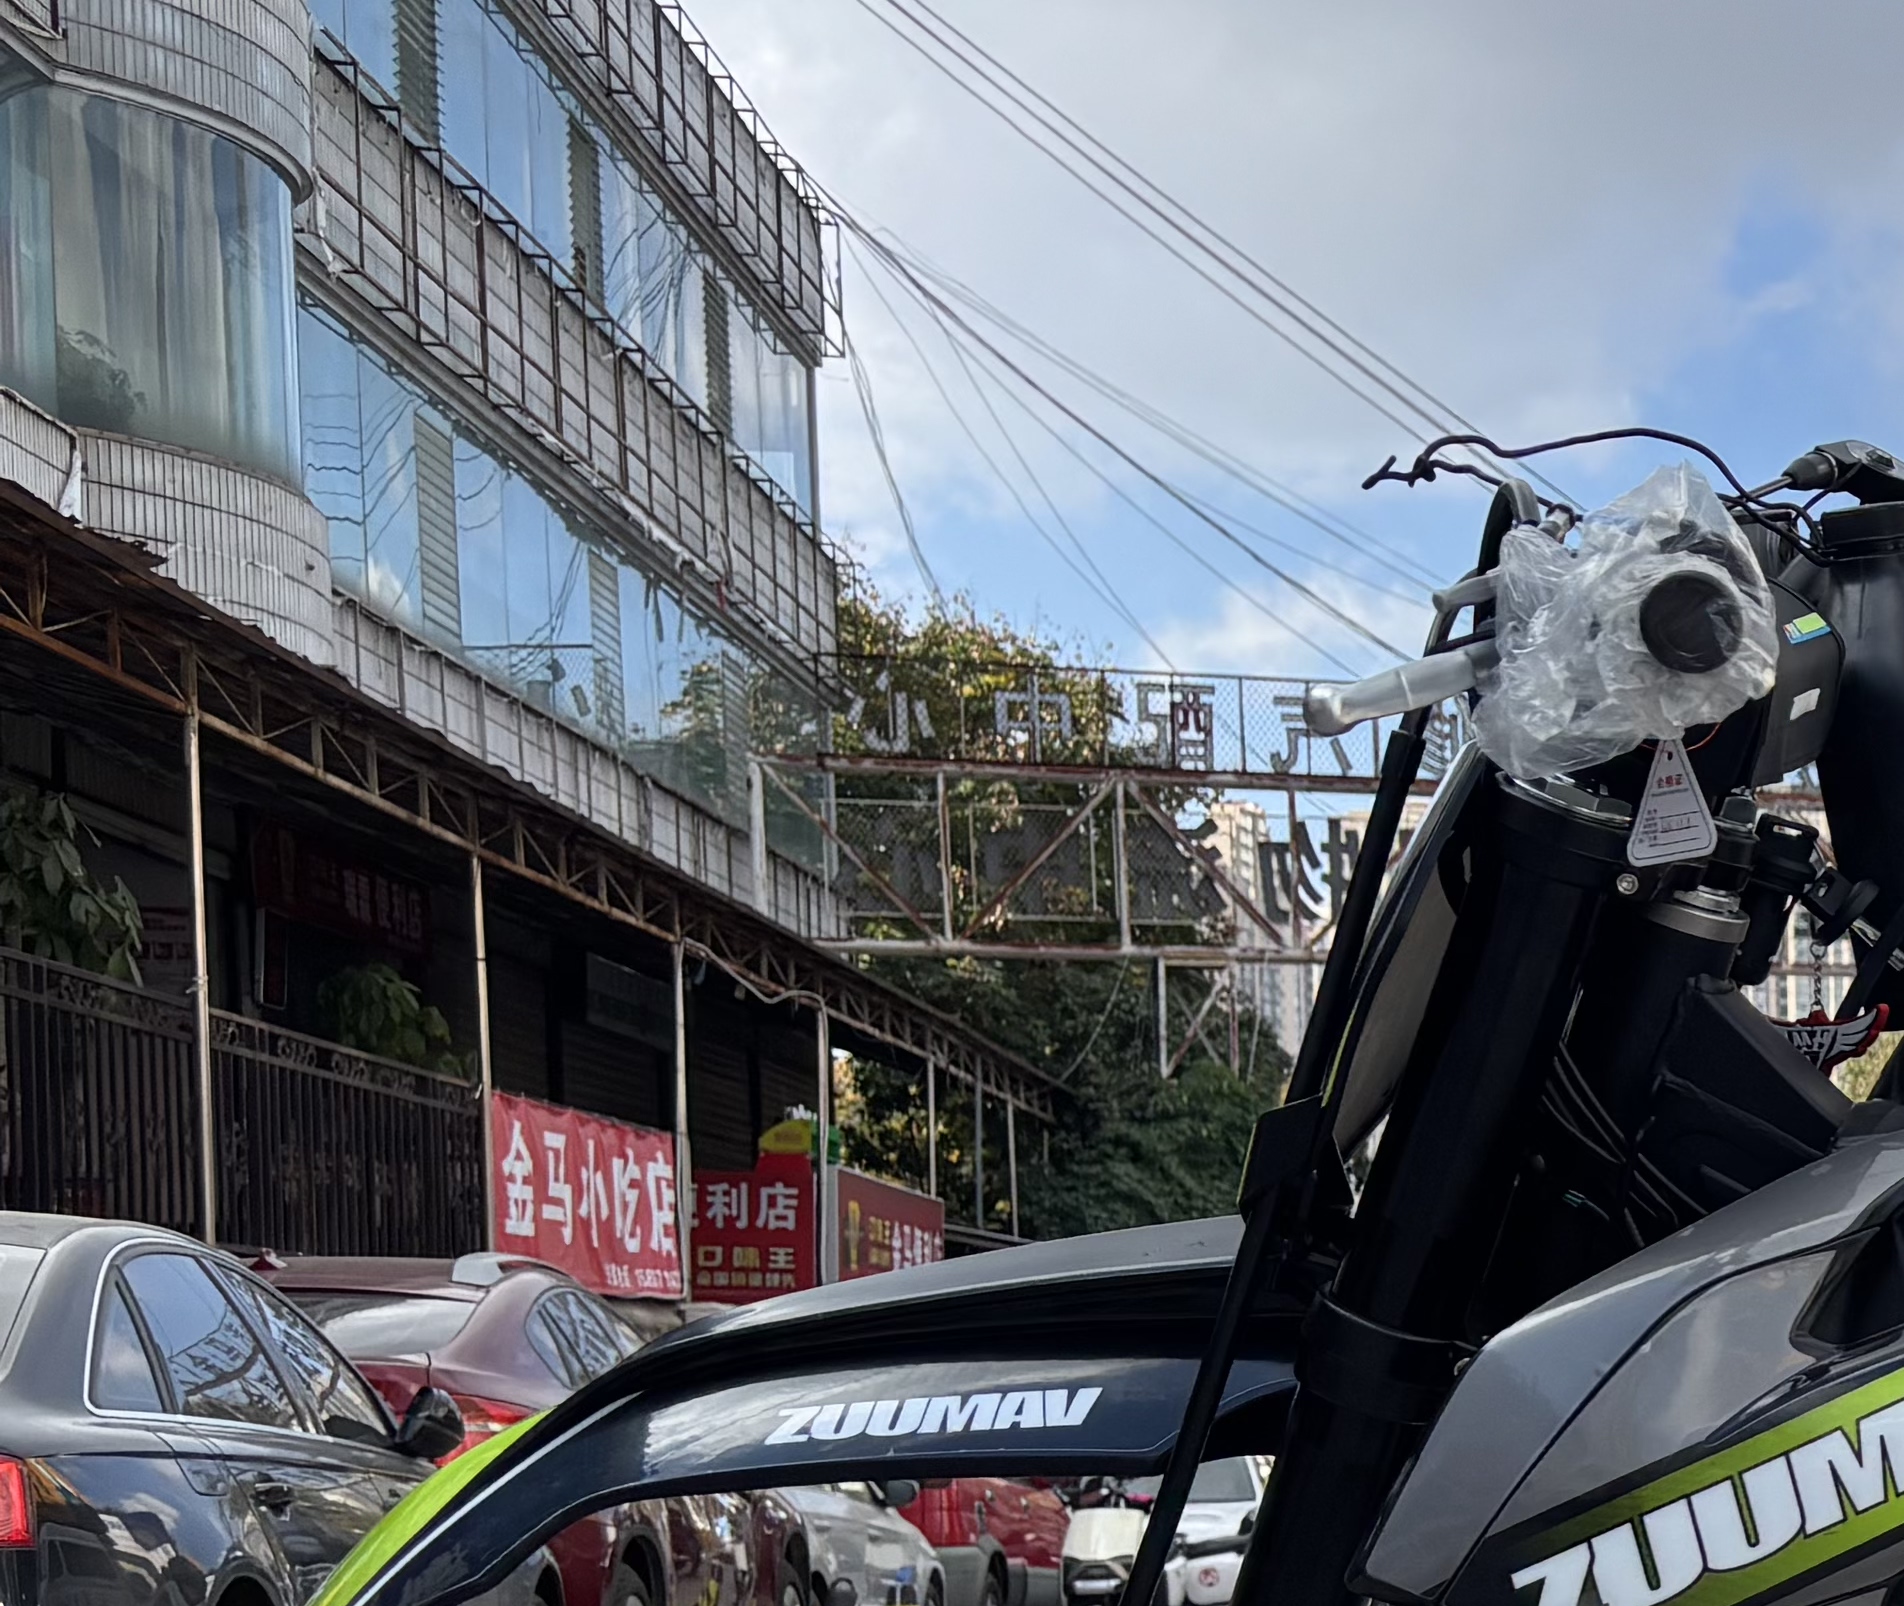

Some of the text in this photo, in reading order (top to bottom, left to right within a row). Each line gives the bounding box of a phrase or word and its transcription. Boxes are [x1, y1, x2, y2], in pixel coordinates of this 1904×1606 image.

[501, 1119, 677, 1258] 金马小吃店
[764, 1387, 1104, 1446] ZUUMAV
